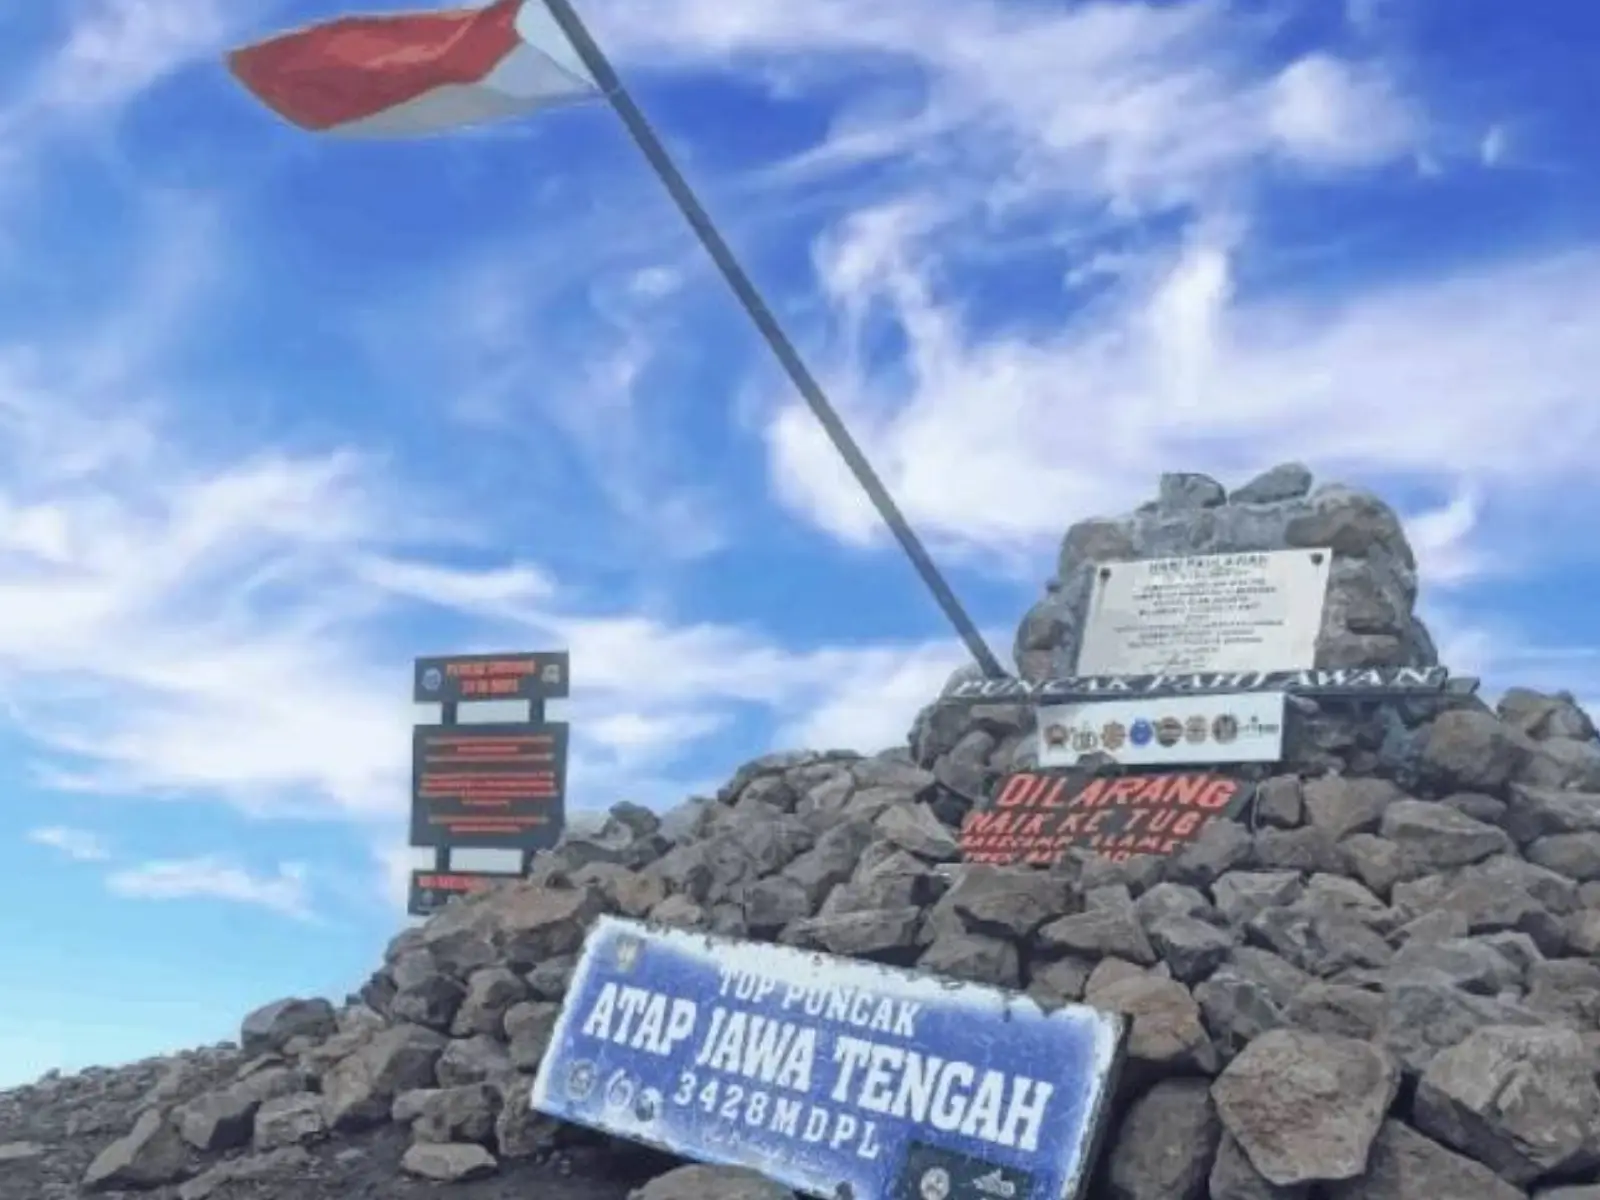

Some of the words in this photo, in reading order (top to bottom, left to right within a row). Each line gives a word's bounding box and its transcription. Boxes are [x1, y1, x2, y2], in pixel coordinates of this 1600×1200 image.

[997, 773, 1238, 808] DILARANG
[963, 811, 1054, 834] NAIK
[1056, 811, 1113, 833] KE
[1123, 809, 1214, 835] TUG
[720, 967, 775, 1003] TOP
[781, 983, 922, 1038] PUNCAK
[582, 982, 697, 1056] ATAP
[696, 1007, 815, 1093] JAWA
[832, 1036, 1054, 1152] TENGAH
